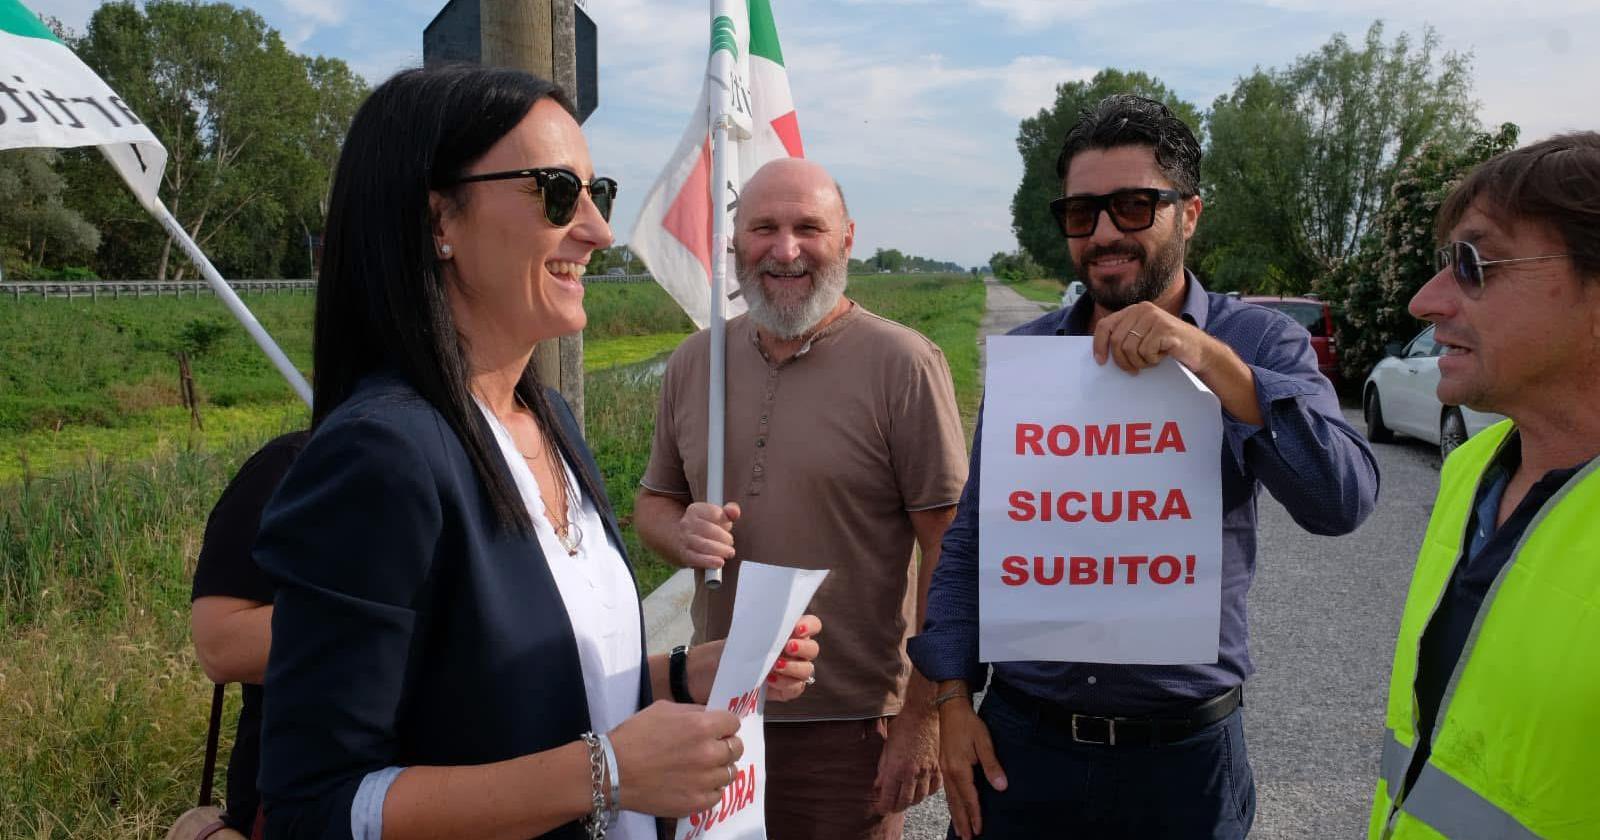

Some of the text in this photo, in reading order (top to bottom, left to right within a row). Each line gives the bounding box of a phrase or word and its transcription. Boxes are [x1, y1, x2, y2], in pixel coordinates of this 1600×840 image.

[1015, 421, 1187, 456] ROMEA
[1007, 488, 1192, 523] SICURA
[1000, 554, 1197, 586] SUBITO!
